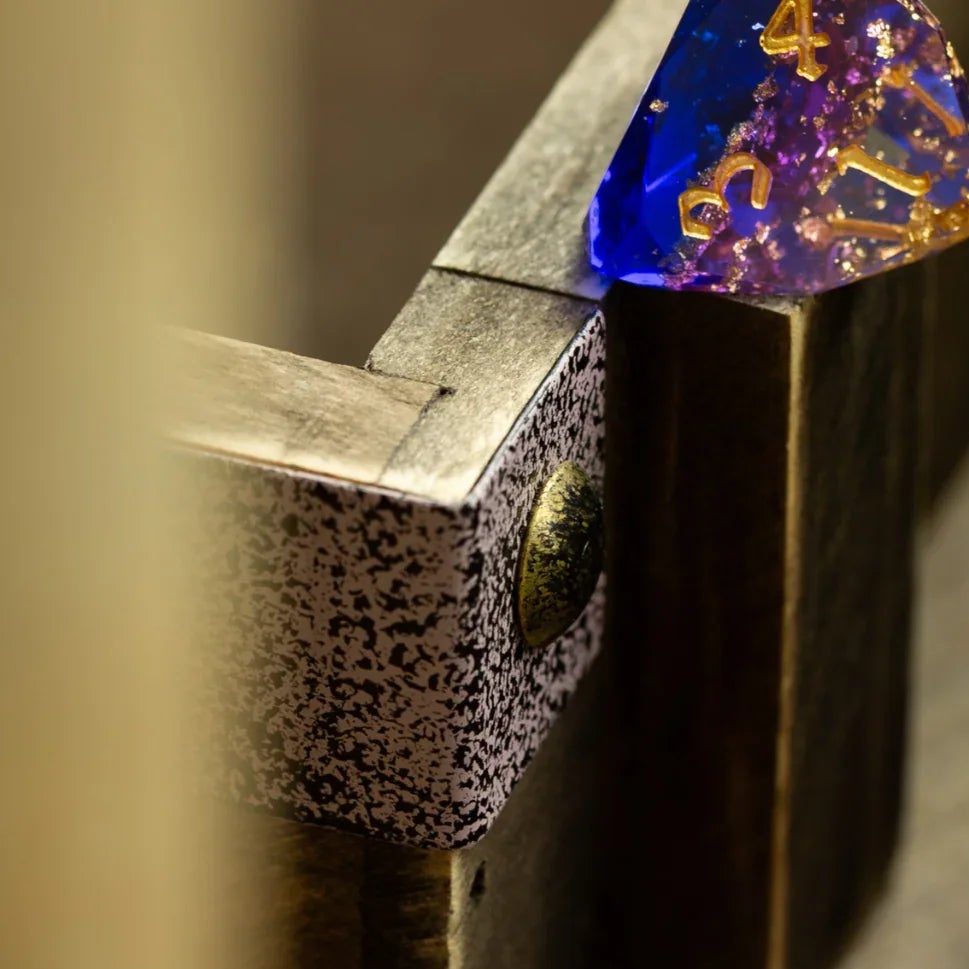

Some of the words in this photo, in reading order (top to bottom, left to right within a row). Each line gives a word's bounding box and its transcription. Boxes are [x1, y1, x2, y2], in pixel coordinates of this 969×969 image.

[760, 0, 831, 82] 4
[678, 151, 773, 240] 3
[836, 143, 931, 198] 1
